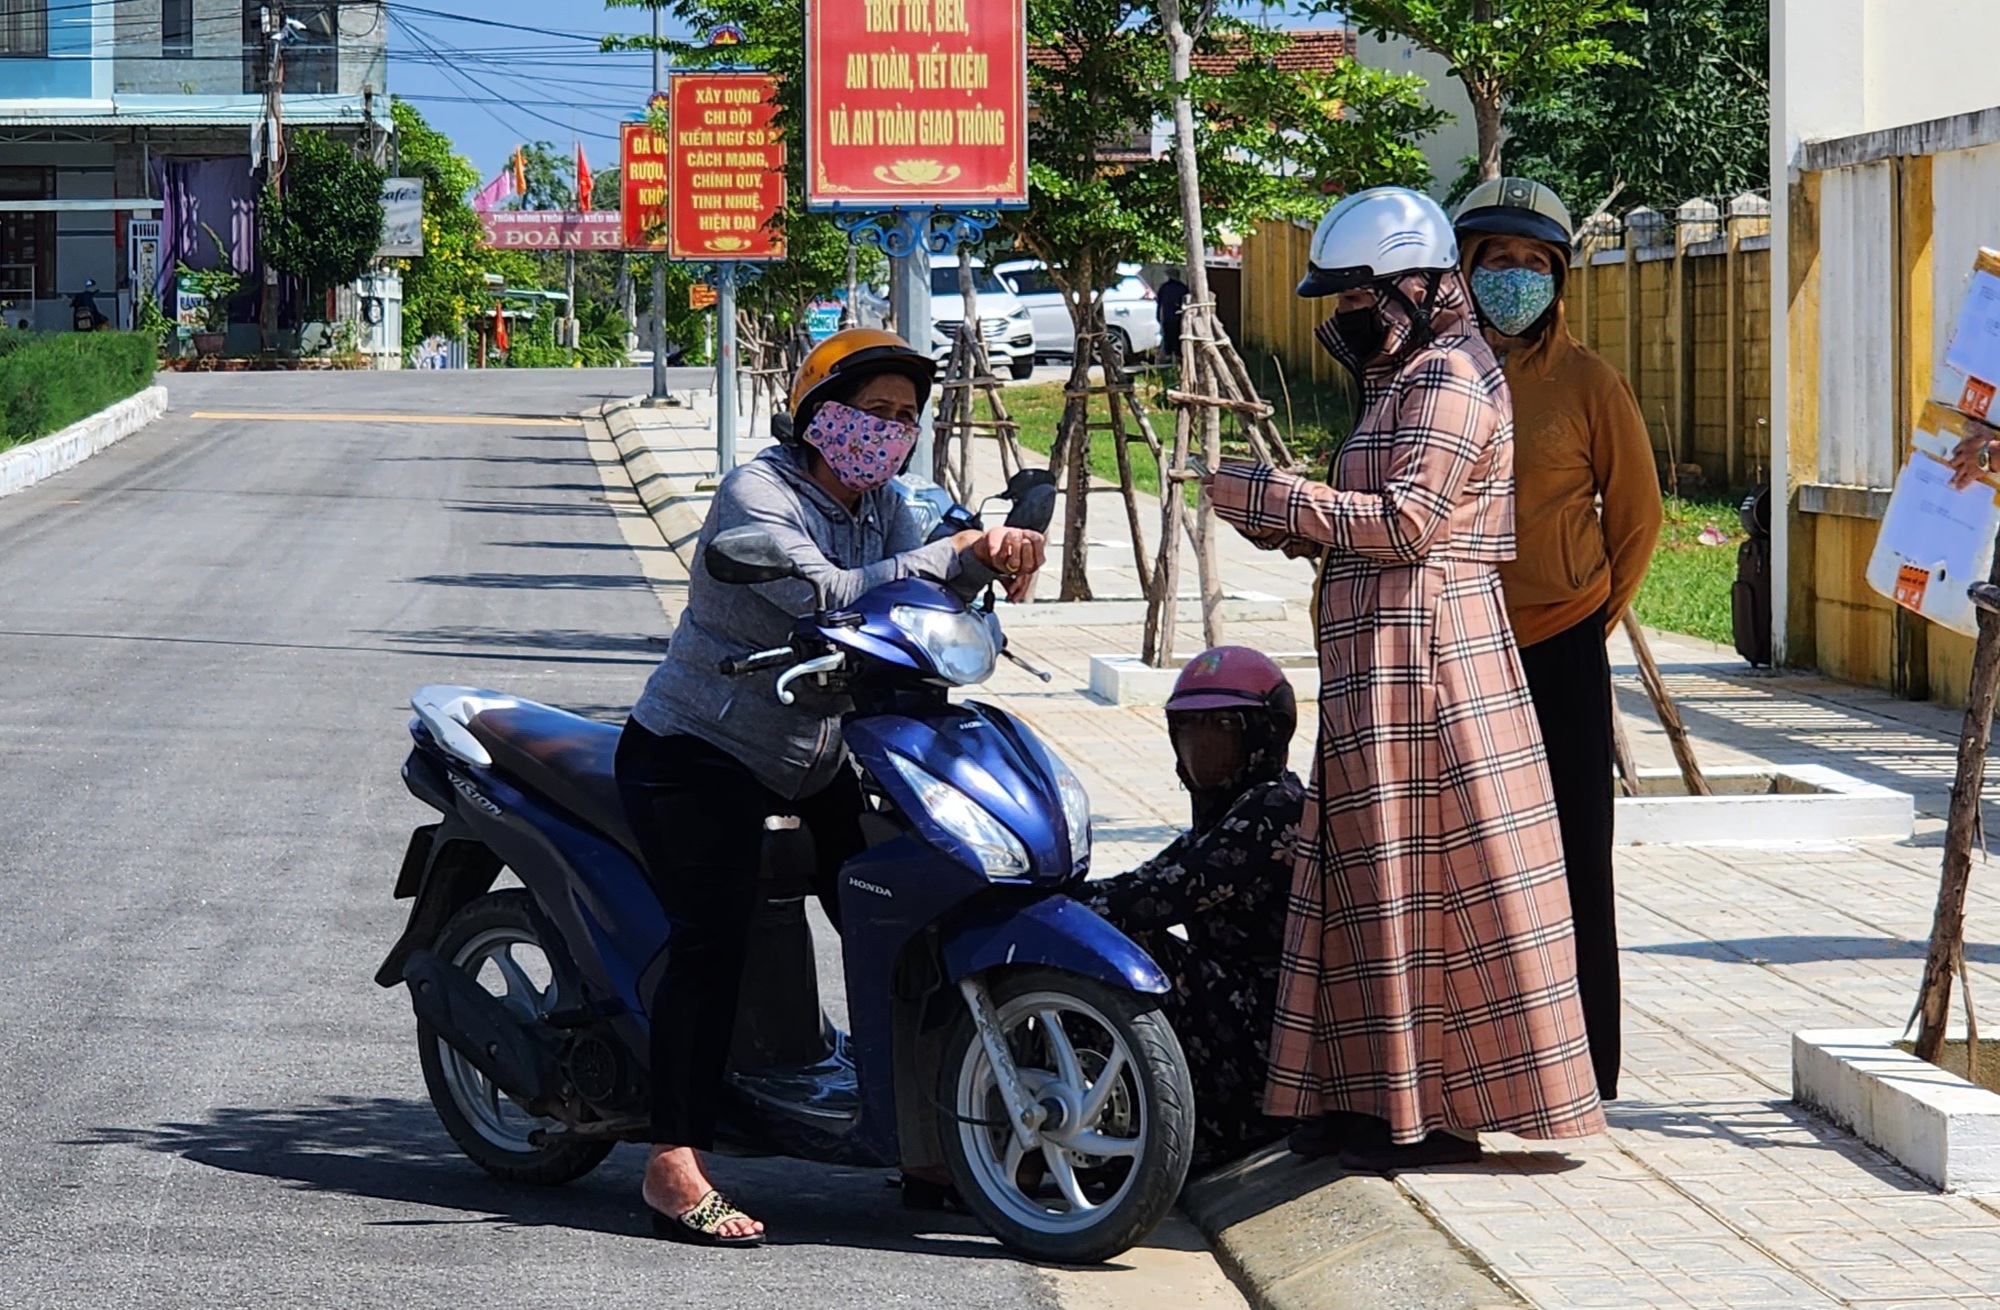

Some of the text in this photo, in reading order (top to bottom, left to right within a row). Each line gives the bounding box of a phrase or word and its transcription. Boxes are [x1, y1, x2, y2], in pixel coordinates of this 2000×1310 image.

[846, 42, 988, 96] AN TOÀN, TIẾT KIỆM
[696, 86, 721, 104] XÂY
[704, 110, 726, 125] CHI
[829, 102, 1005, 146] VÀ AN TOÀN GIAO THÔNG
[716, 131, 745, 146] NGƯ
[687, 150, 768, 169] CÁCH MẠNG,
[692, 172, 763, 189] CHÍNH QUY,
[691, 192, 764, 211] TINH NHUỆ,
[699, 213, 730, 232] HIỆN
[505, 226, 583, 246] ĐOÀN
[849, 876, 893, 898] HONDA
